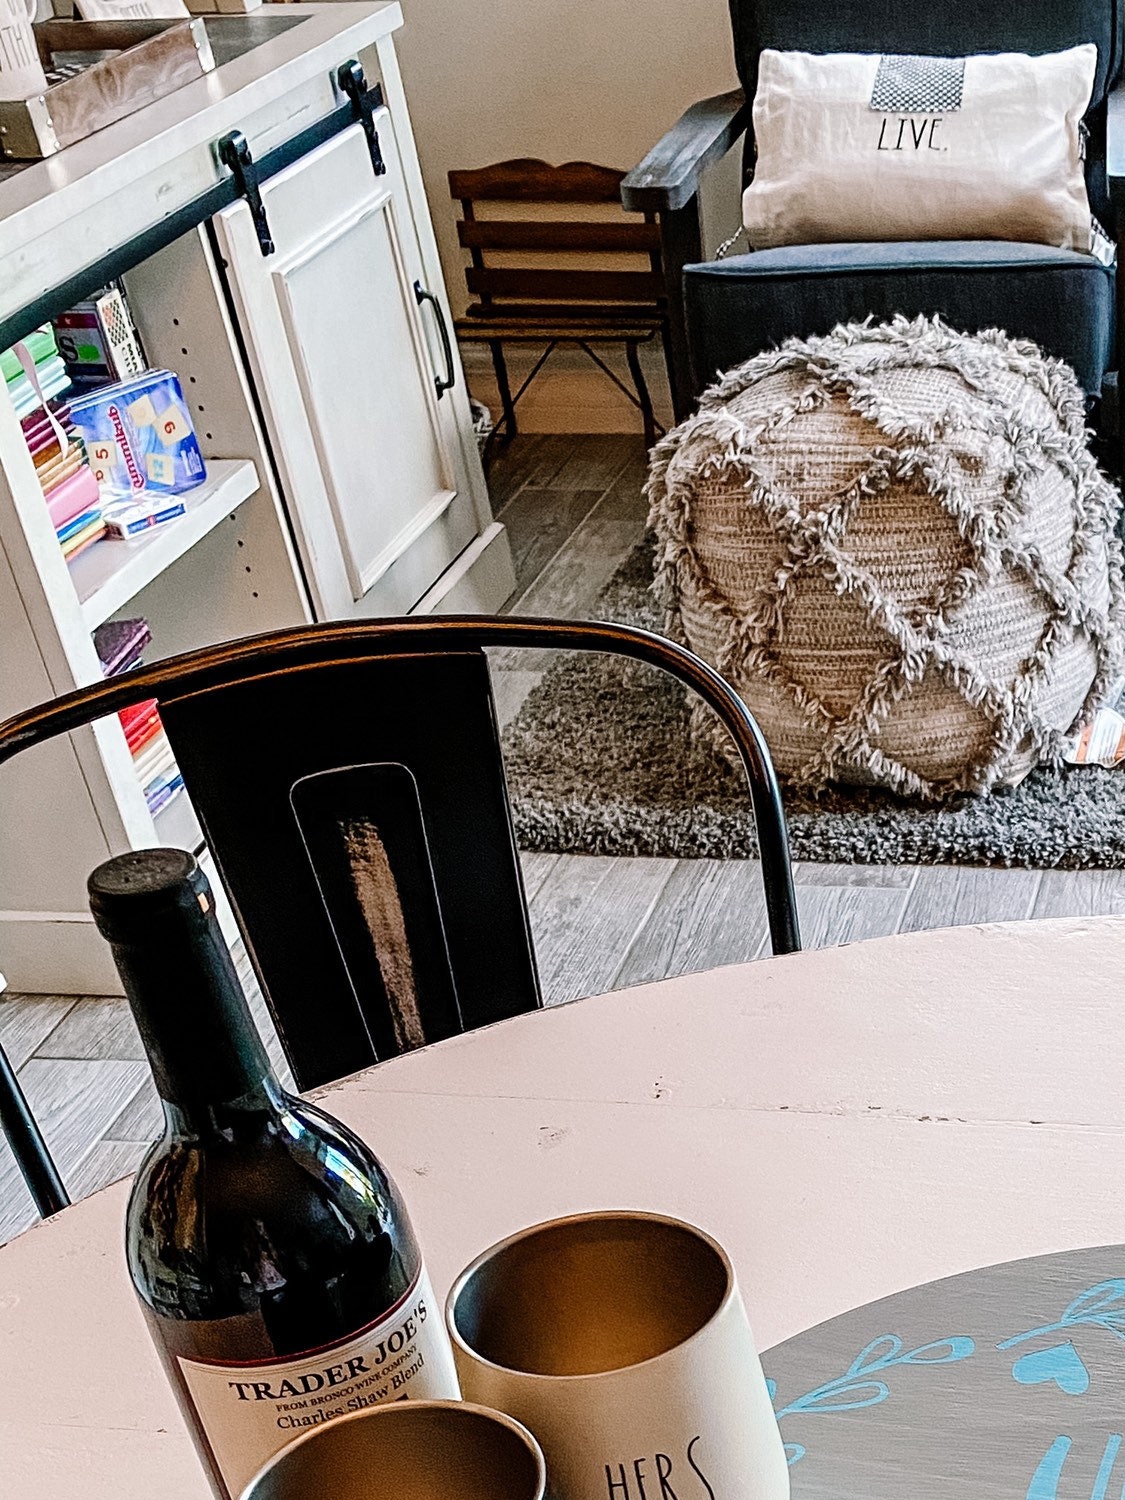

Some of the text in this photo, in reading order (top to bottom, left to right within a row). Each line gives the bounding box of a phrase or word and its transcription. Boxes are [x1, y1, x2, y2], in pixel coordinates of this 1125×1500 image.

[878, 118, 947, 150] LIVE.
[229, 1299, 428, 1400] TRADER JOE'S
[276, 1342, 417, 1412] FROM BRONCO WINE COMPANY
[277, 1353, 425, 1429] Charles Shaw Blend
